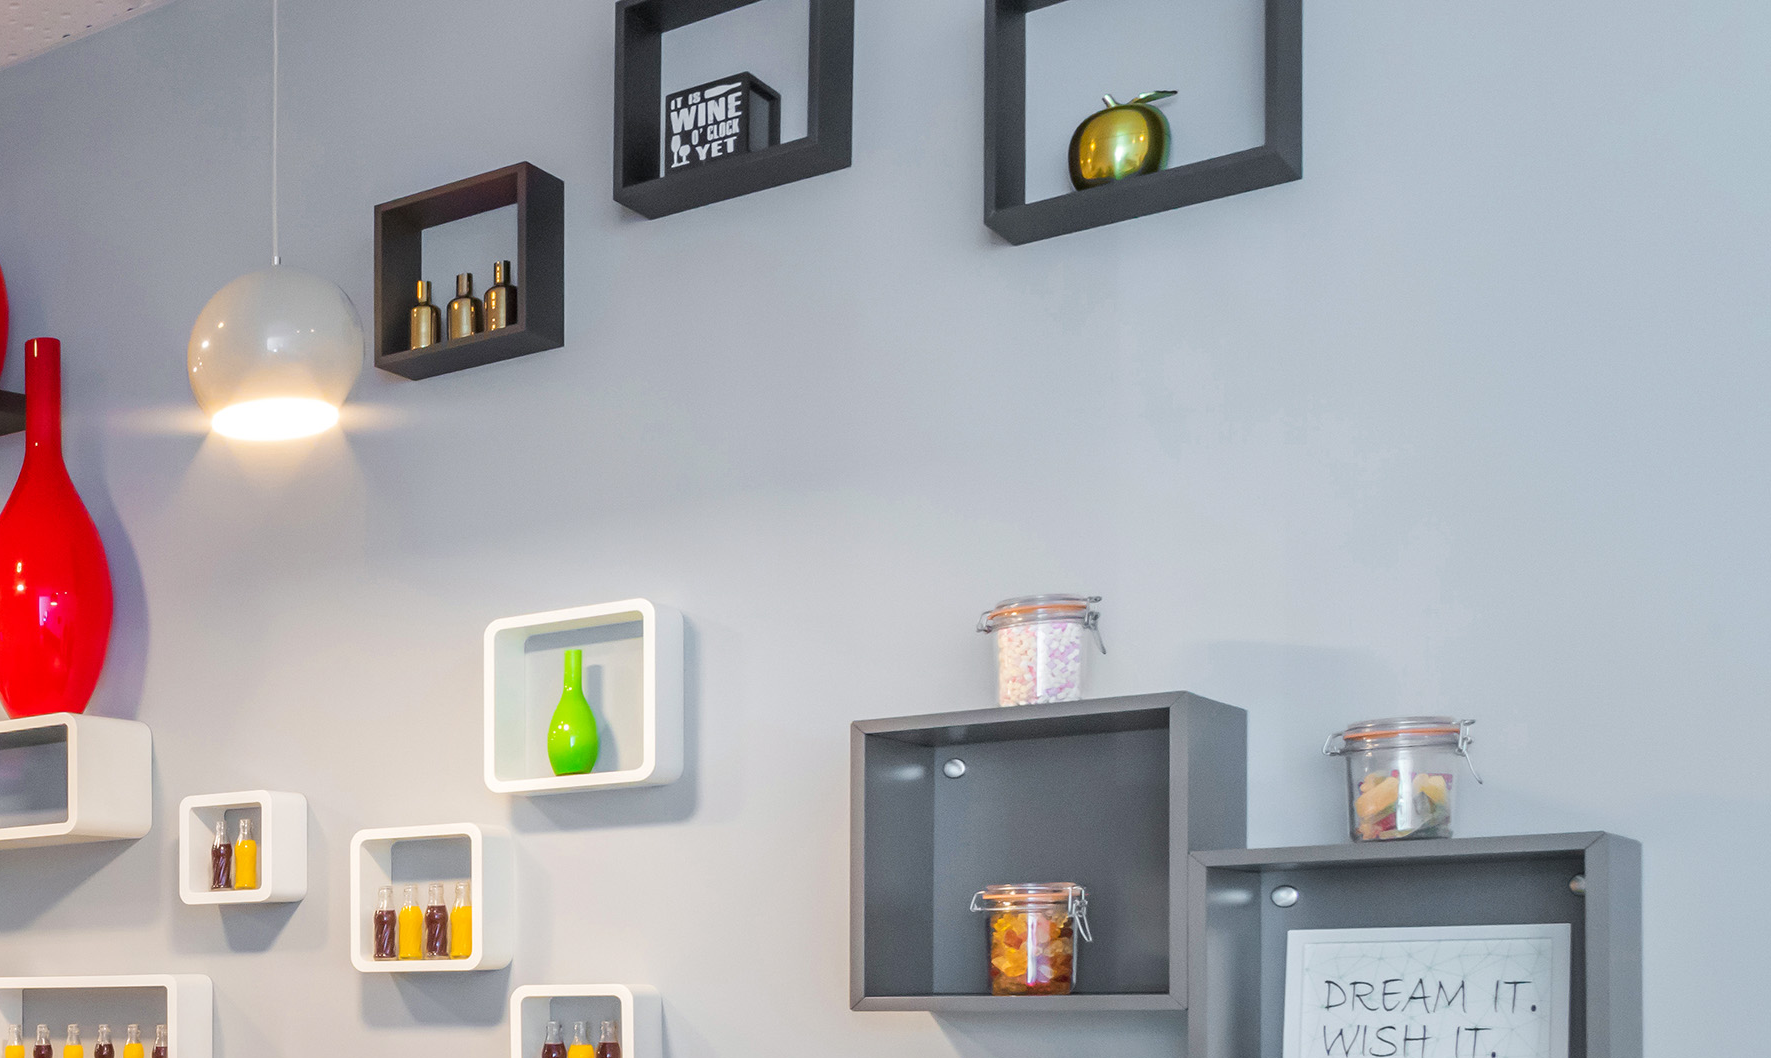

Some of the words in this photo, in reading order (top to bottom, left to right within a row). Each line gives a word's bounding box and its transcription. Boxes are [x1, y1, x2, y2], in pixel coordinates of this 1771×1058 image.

[670, 96, 683, 110] IT
[688, 91, 701, 105] IS
[670, 91, 742, 134] WINE
[695, 136, 737, 161] YET
[1324, 978, 1467, 1014] DREAM
[1494, 979, 1537, 1013] IT.
